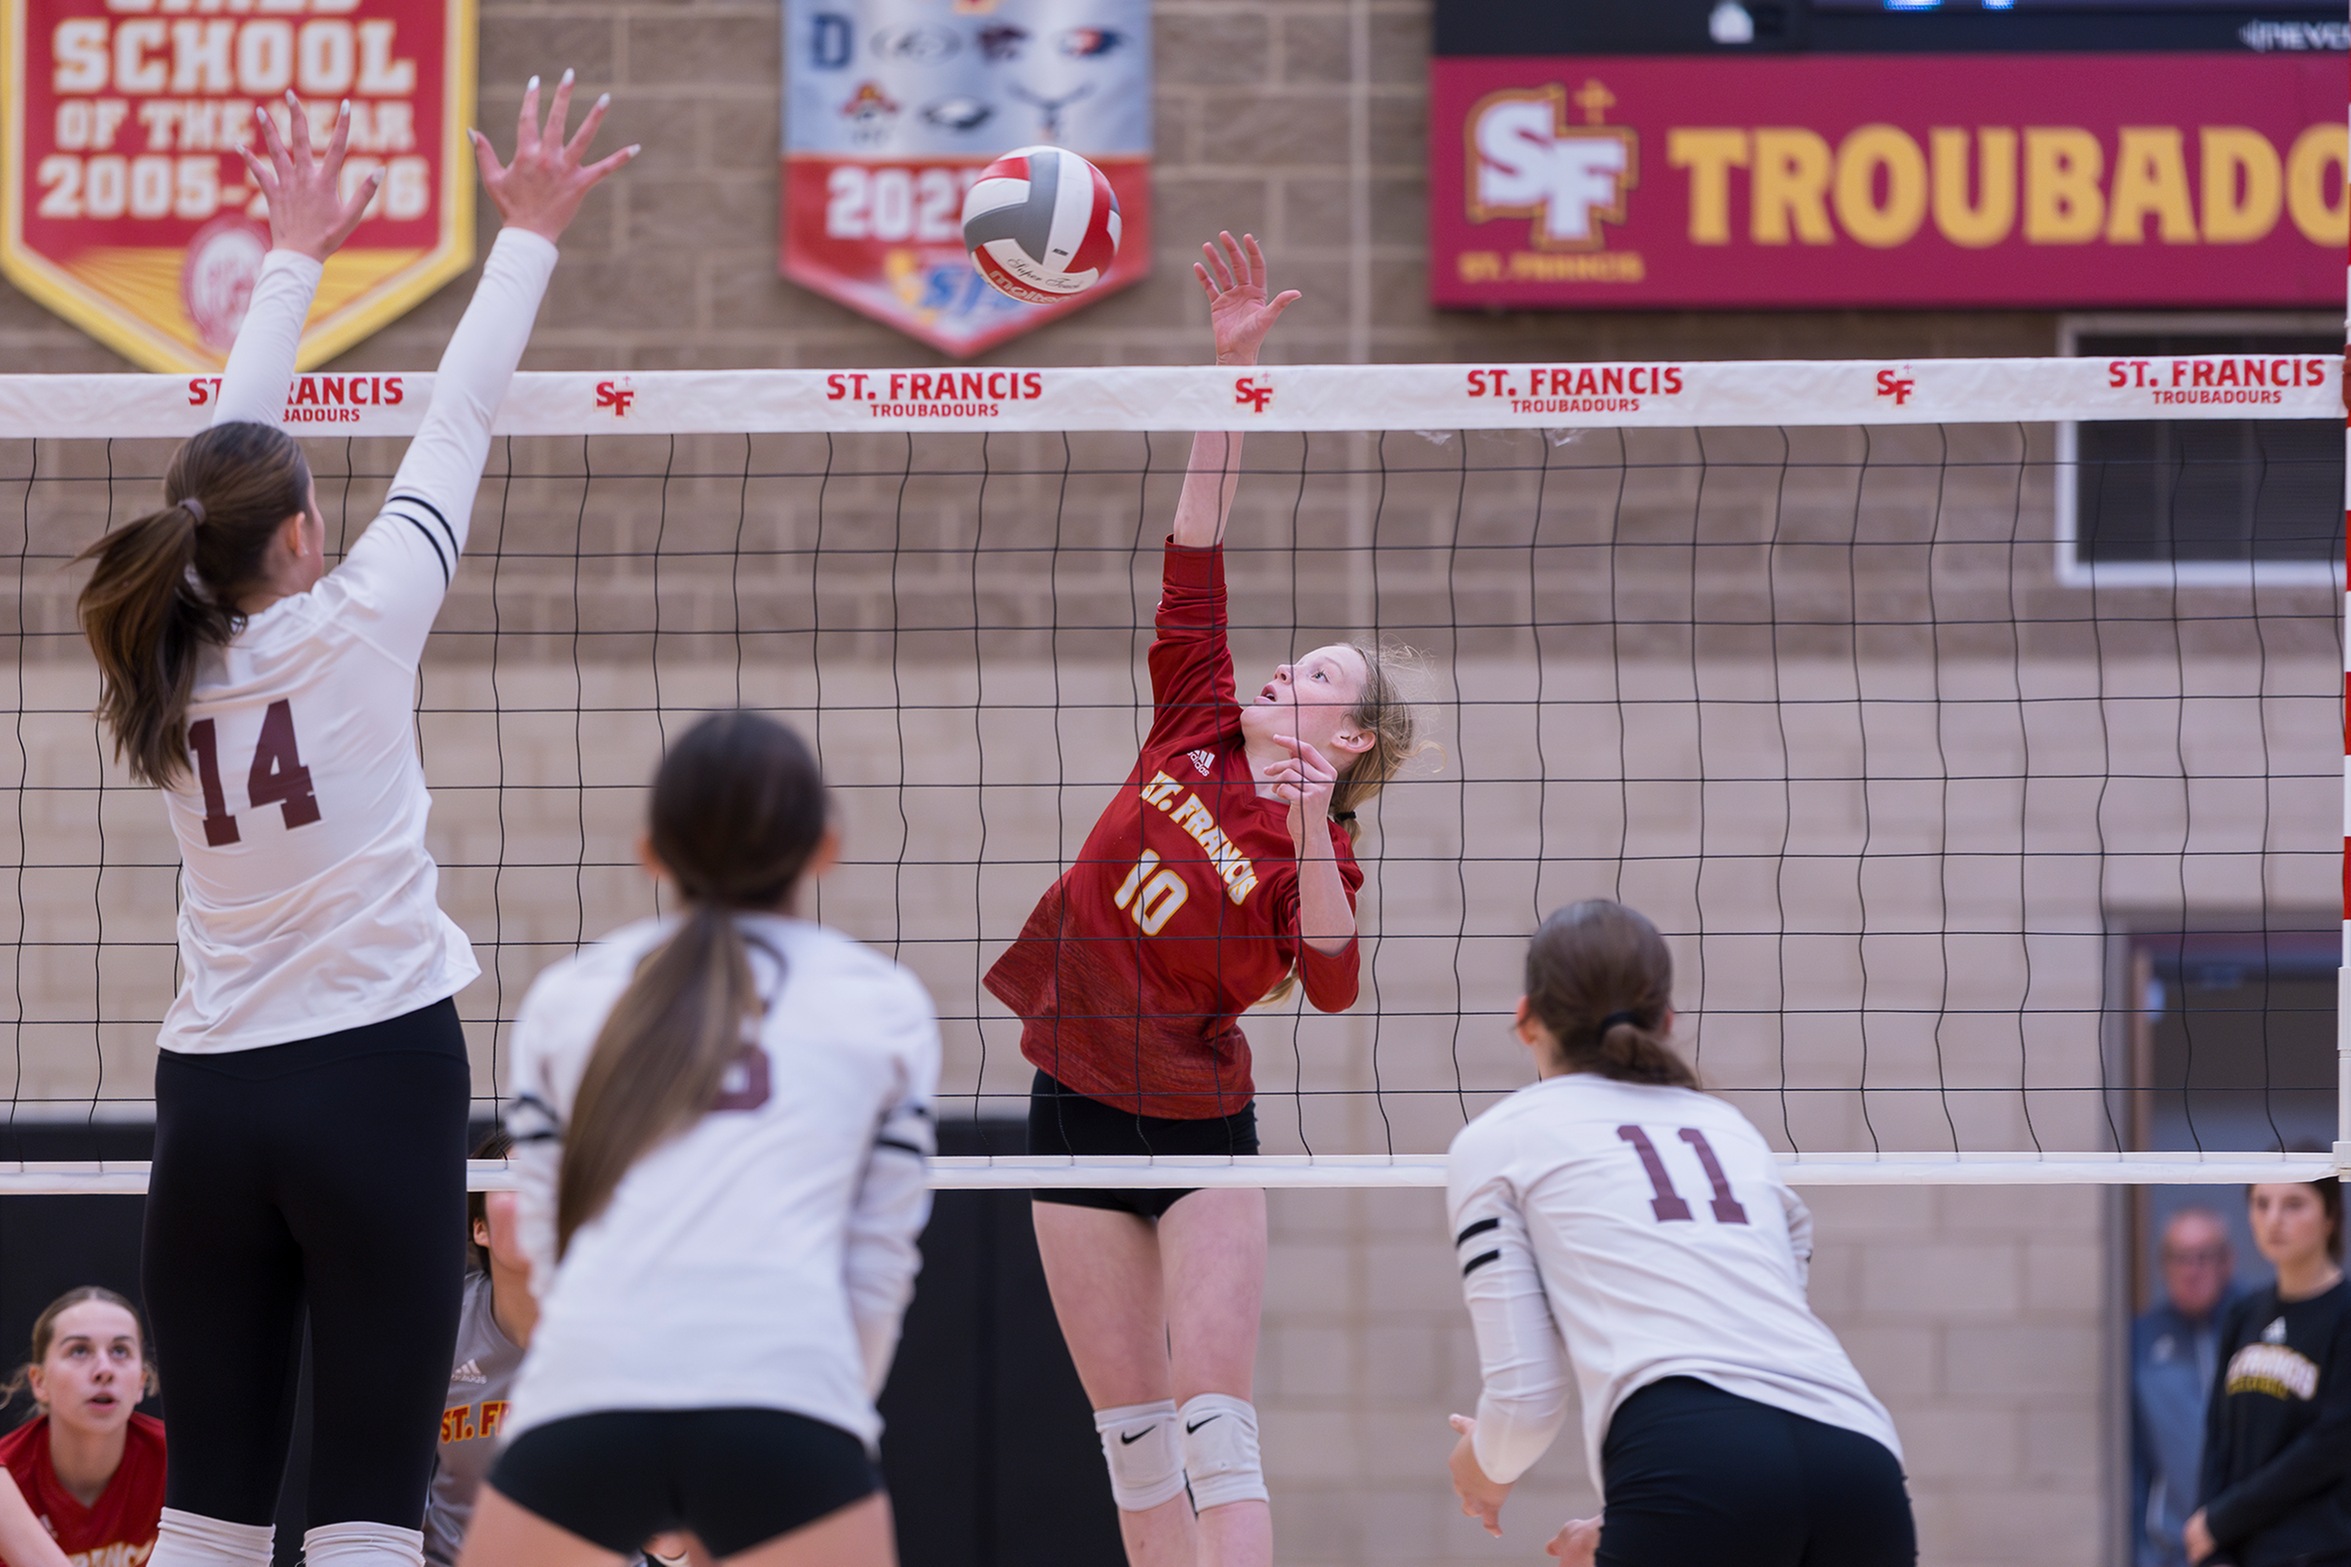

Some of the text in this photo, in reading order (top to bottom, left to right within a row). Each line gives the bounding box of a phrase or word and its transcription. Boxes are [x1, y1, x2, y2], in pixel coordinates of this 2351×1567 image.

[52, 18, 418, 94] SCHOOL
[55, 100, 130, 152] OF
[136, 100, 260, 152] THE
[1470, 90, 1633, 245] SF
[37, 155, 430, 220] 2005-06
[826, 166, 982, 242] 202
[826, 372, 1042, 400] ST. FRANCIS
[1467, 367, 1683, 397] ST. FRANCIS
[1876, 369, 1914, 405] SF
[2108, 359, 2326, 388] ST. FRANCIS
[596, 381, 634, 416] SF
[870, 403, 999, 417] TROUBADOURS
[1235, 377, 1273, 413] SF
[1511, 398, 1640, 413] TROUBADOURS
[2152, 390, 2282, 404] TROUBADOURS
[188, 697, 322, 848] 14
[1114, 848, 1190, 936] 10
[1616, 1124, 1750, 1225] 11
